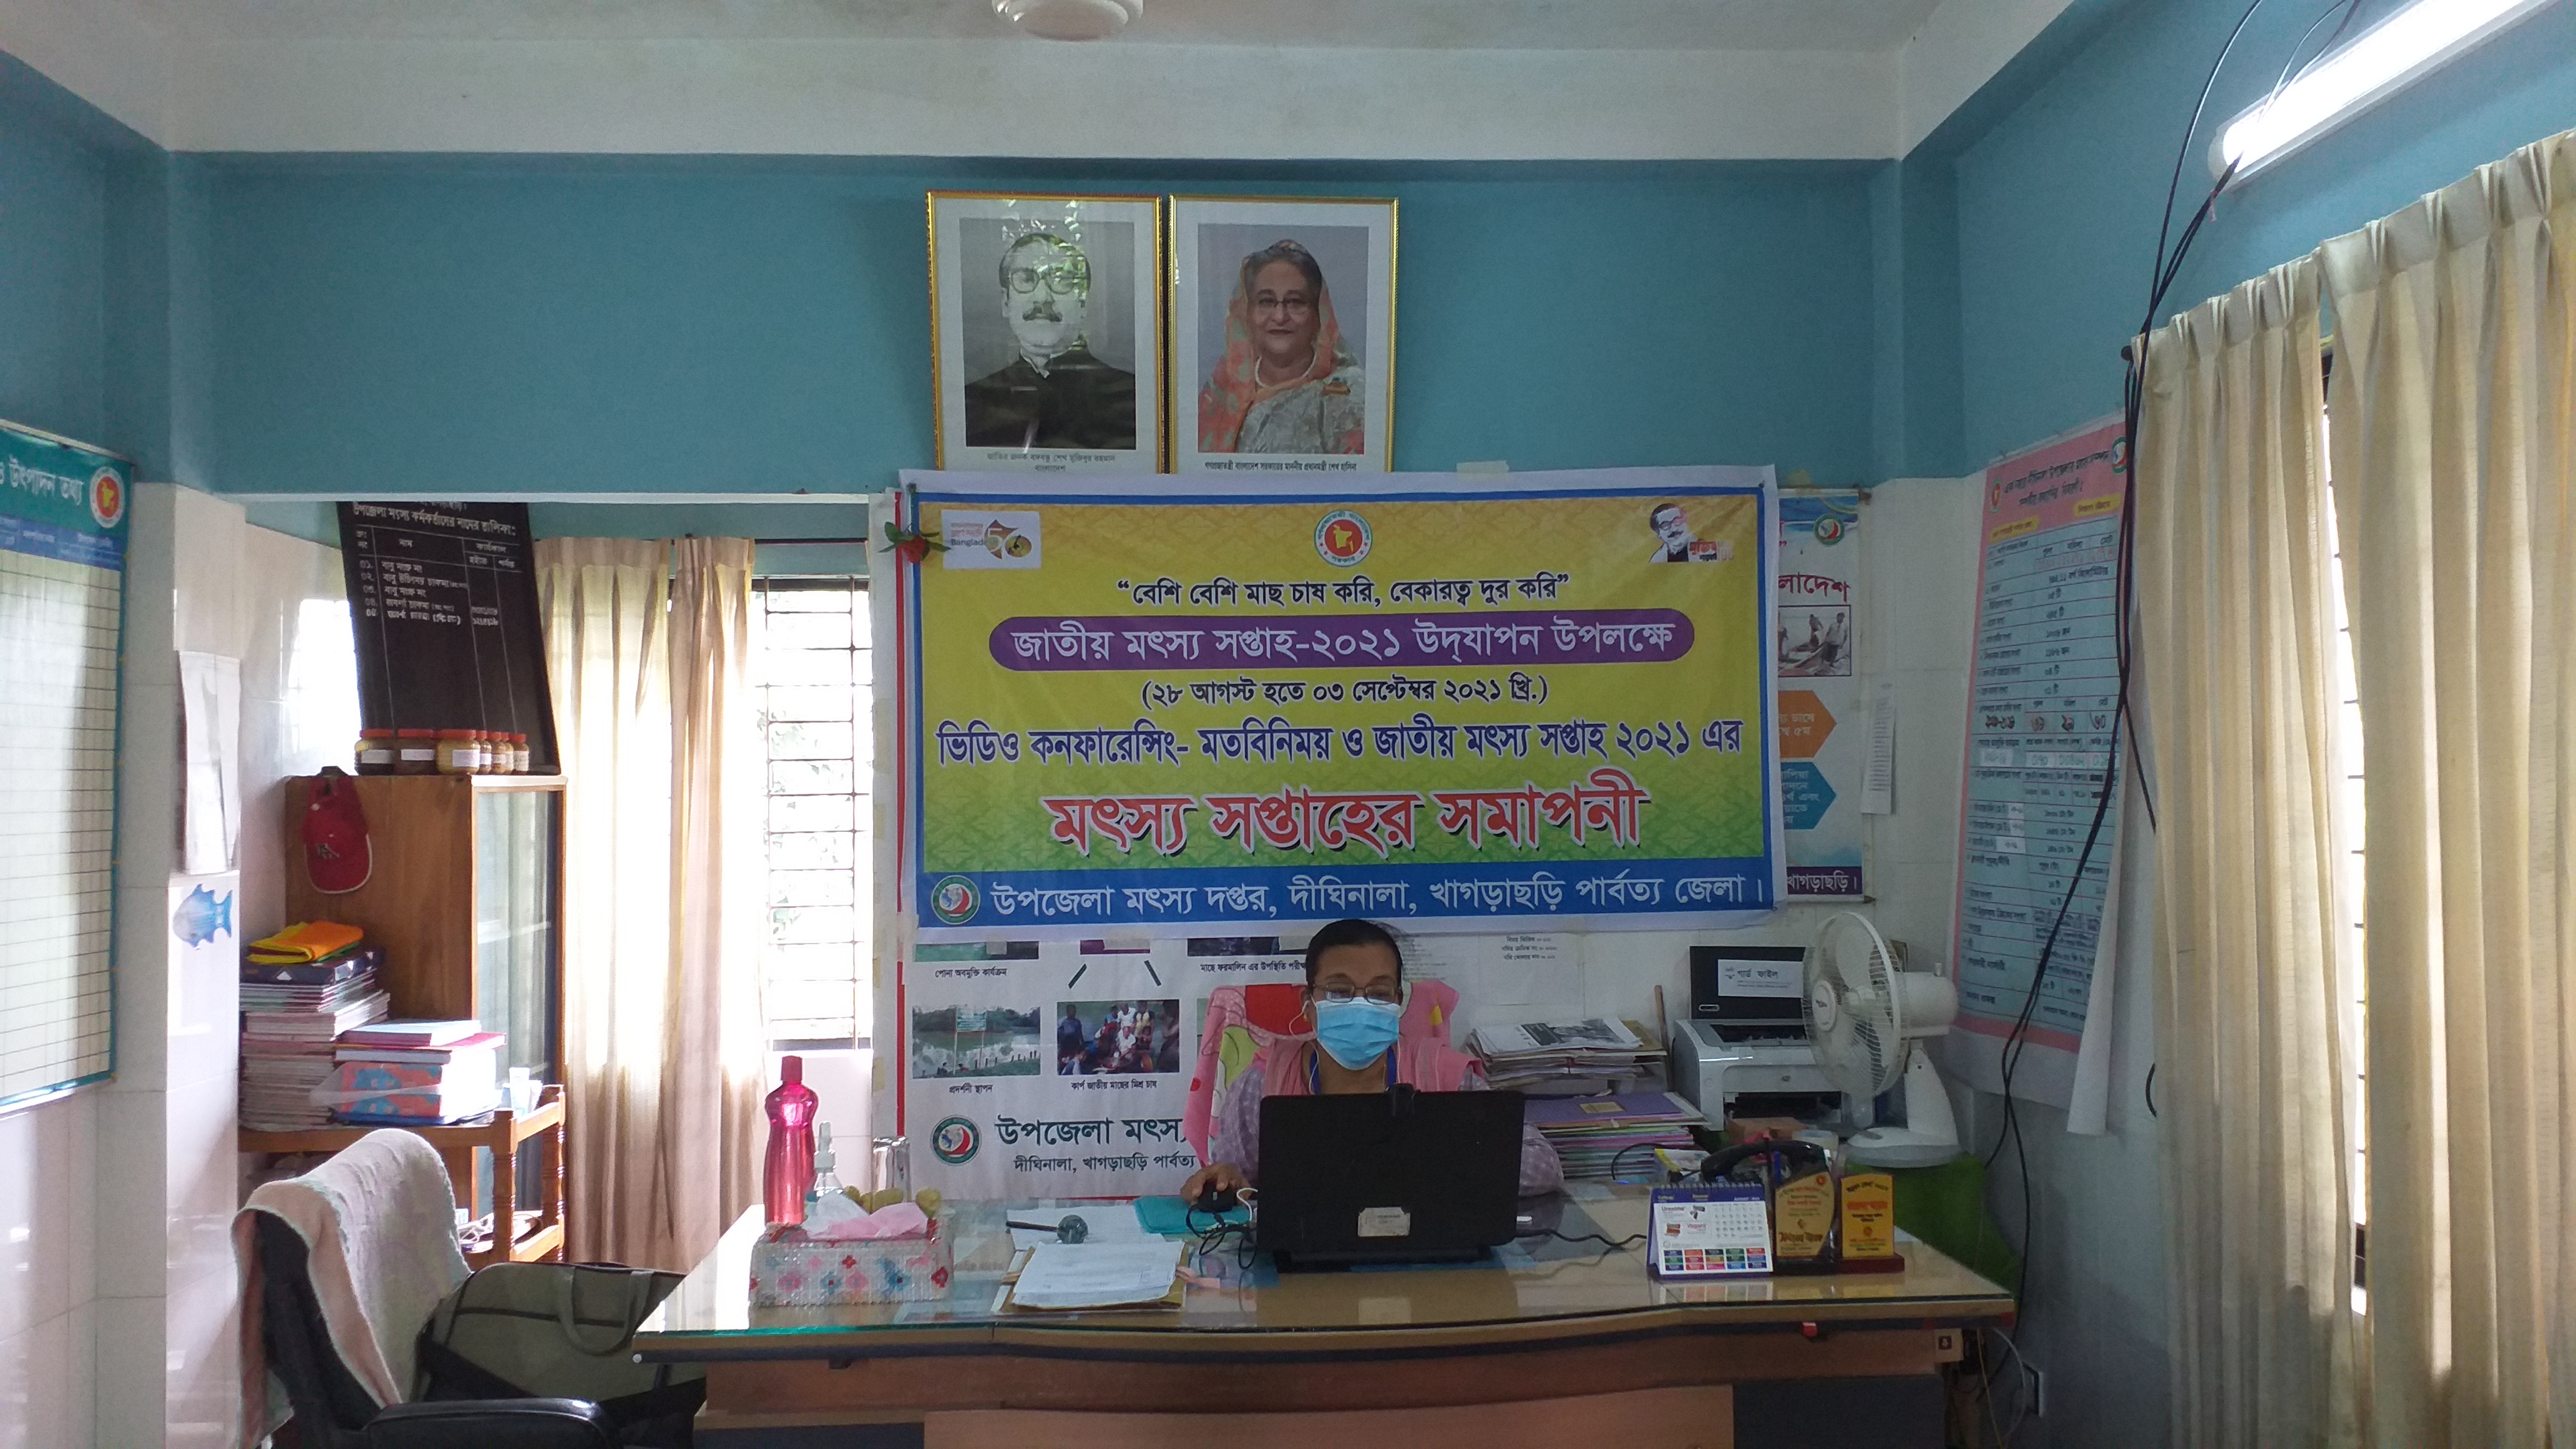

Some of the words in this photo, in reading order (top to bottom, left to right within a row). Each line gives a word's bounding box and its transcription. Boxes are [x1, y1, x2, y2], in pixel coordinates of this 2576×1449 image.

[1117, 577, 1183, 605] “বেশি
[1189, 577, 1239, 605] বেশি
[1244, 580, 1286, 607] মাছ
[1289, 580, 1327, 604] চাষ
[1332, 575, 1381, 608] করি,
[1390, 578, 1473, 606] বেকারত্ব
[1478, 579, 1511, 605] দুর
[1515, 570, 1569, 600] করি”
[1778, 571, 1851, 603] লাদেশ
[1010, 620, 1116, 662] জাতীয়
[1121, 630, 1206, 661] মৎস্য
[1211, 627, 1401, 663] সপ্তাহ-২০২১
[1549, 615, 1677, 654] উপলক্ষে
[1141, 680, 1183, 711] (২৮
[1189, 675, 1257, 705] আগস্ট
[1261, 682, 1307, 706] হতে
[1312, 682, 1345, 701] ০৩
[1352, 673, 1438, 703] সেপ্টেম্বর
[1443, 679, 1502, 704] ২০২১
[935, 719, 1020, 766] ভিডিও
[1196, 716, 1334, 764] মতবিনিময়
[1342, 728, 1364, 758] ও
[1371, 713, 1458, 760] জাতীয়
[1463, 721, 1532, 759] মৎস্য
[1537, 719, 1609, 760] সপ্তাহ
[1616, 720, 1690, 760] ২০২১
[1702, 720, 1744, 754] এর
[1041, 796, 1196, 857] মৎস্য
[1203, 786, 1425, 861] সপ্তাহের
[1430, 767, 1651, 851] সমাপনী
[990, 882, 1116, 917] উপজেলা
[1121, 887, 1197, 915] মৎস্য
[1204, 883, 1278, 918] দপ্তর,
[1287, 874, 1418, 915] দীঘিনালা,
[1430, 871, 1566, 912] খাগড়াছড়ি
[1575, 868, 1666, 906] পার্বত্য
[935, 968, 953, 977] পোনা
[1200, 963, 1216, 973] মাছে
[1217, 961, 1246, 972] ফরমালিন
[1261, 960, 1286, 973] উপস্থিতি
[1288, 959, 1307, 971] পরীক্ষ
[1757, 969, 1778, 978] ফাইল
[1071, 1080, 1085, 1091] কার্প
[1087, 1079, 1108, 1090] জাতীয়
[1110, 1080, 1129, 1090] মাছের
[1145, 1079, 1158, 1090] চাষ
[994, 1115, 1115, 1146] উপজেলা
[1121, 1118, 1187, 1144] মৎস
[1013, 1154, 1078, 1174] দীঘিনালা,
[1082, 1152, 1149, 1173] খাগড়াছড়ি
[1153, 1150, 1197, 1169] পার্বত্য
